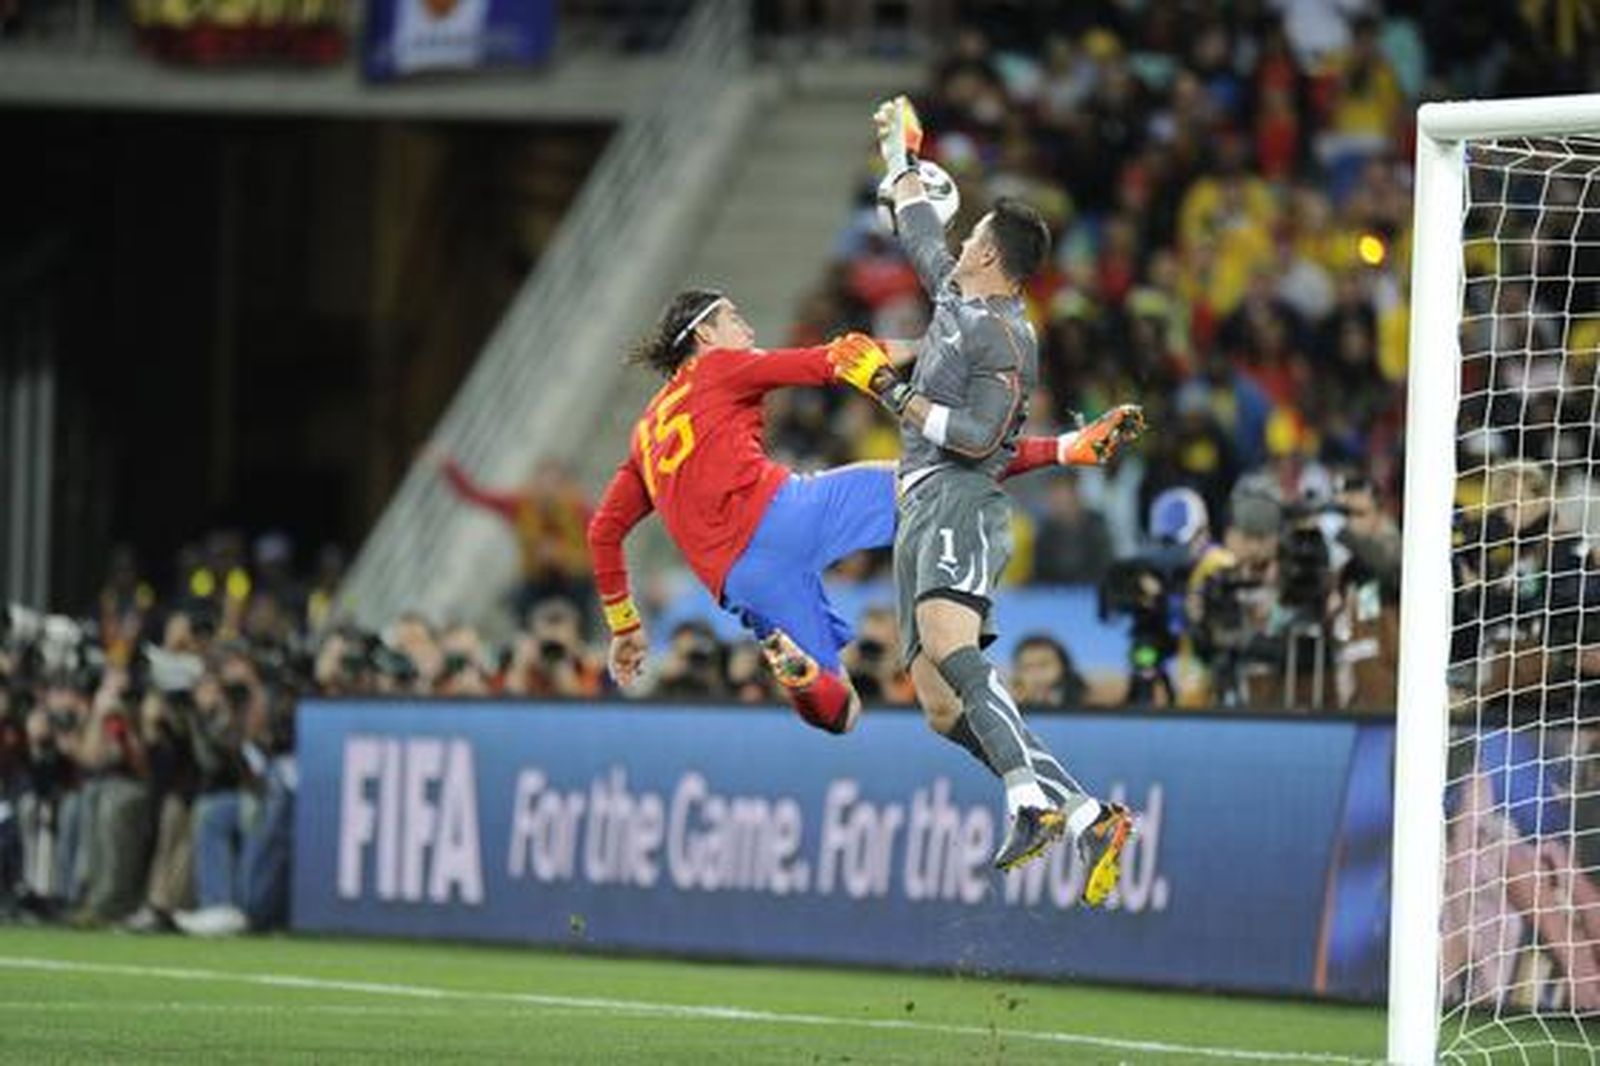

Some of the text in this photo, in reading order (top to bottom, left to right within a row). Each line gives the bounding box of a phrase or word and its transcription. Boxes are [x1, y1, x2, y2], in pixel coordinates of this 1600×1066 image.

[639, 381, 695, 500] 15
[939, 527, 958, 564] 1
[337, 736, 485, 905] FIFA
[507, 767, 586, 882] For
[584, 761, 665, 888] the
[668, 770, 811, 896] Game.
[816, 778, 902, 897] For
[904, 777, 996, 903] the
